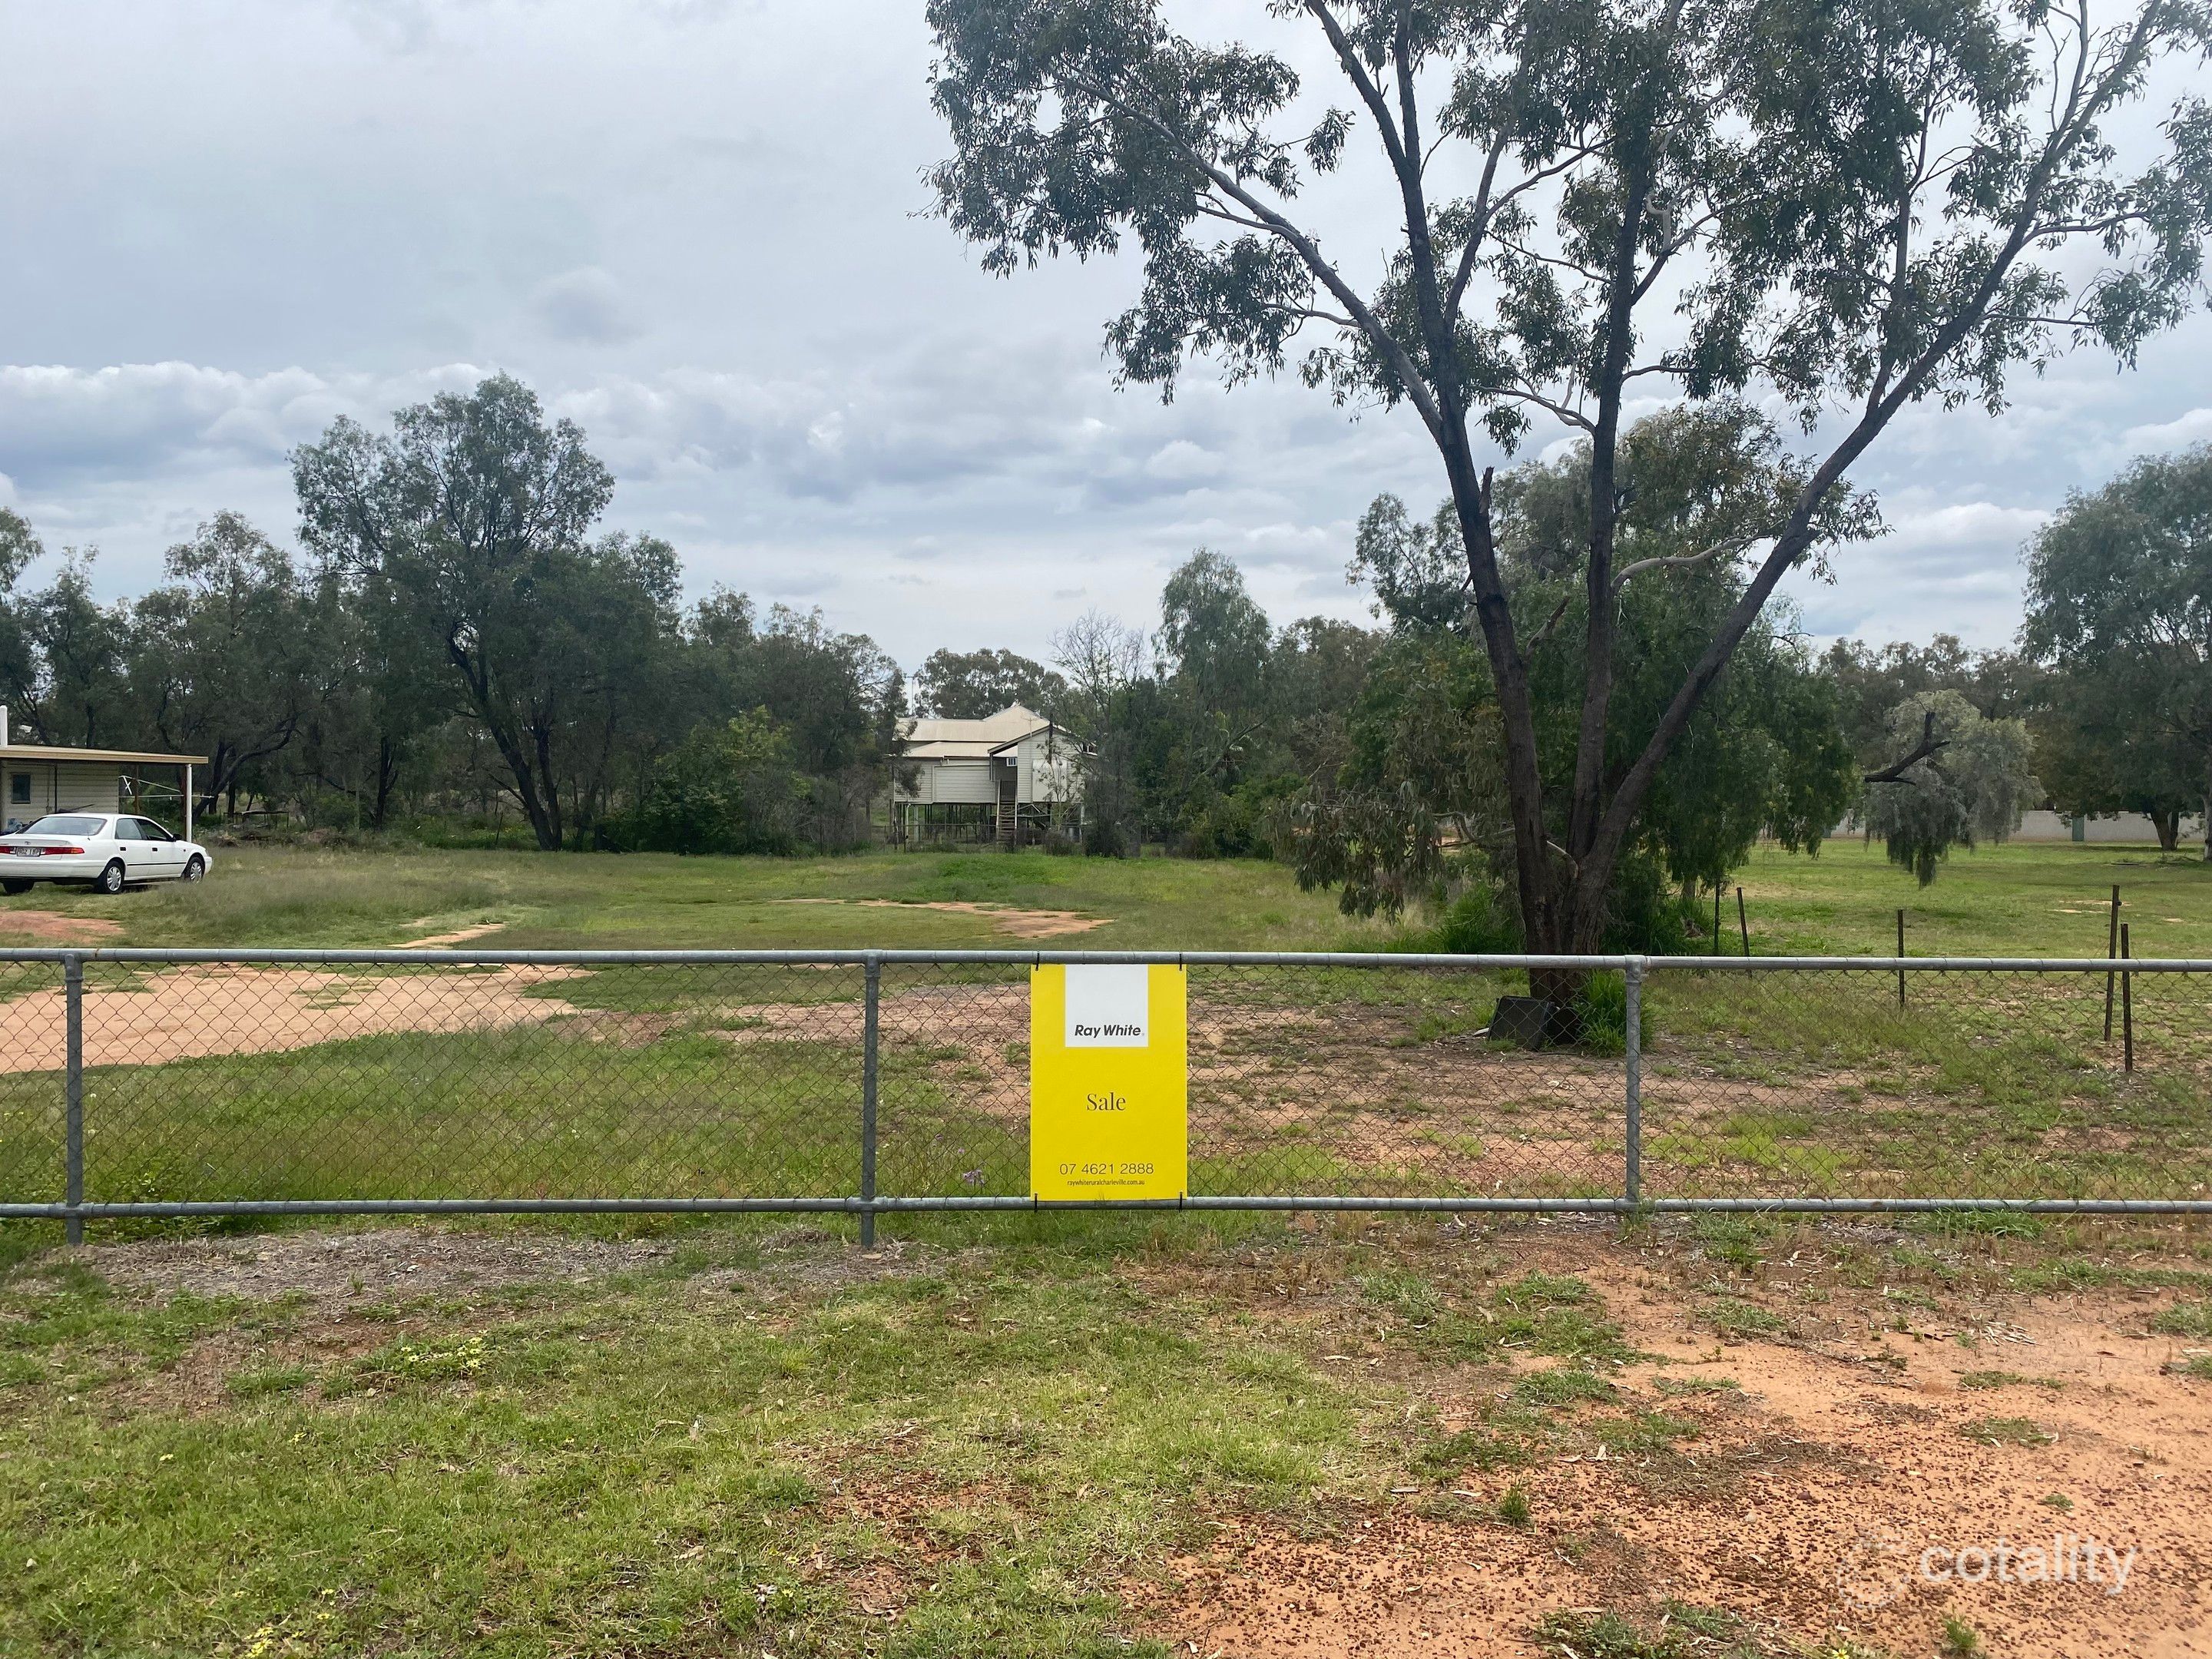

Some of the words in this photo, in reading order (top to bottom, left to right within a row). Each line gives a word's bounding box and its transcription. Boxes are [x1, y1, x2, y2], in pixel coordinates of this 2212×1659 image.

[1075, 1024, 1101, 1038] Ray
[1103, 1024, 1141, 1036] White
[1086, 1091, 1126, 1111] Sale
[1059, 1163, 1077, 1175] 07
[1081, 1163, 1114, 1175] 4621
[1120, 1163, 1154, 1174] 2888
